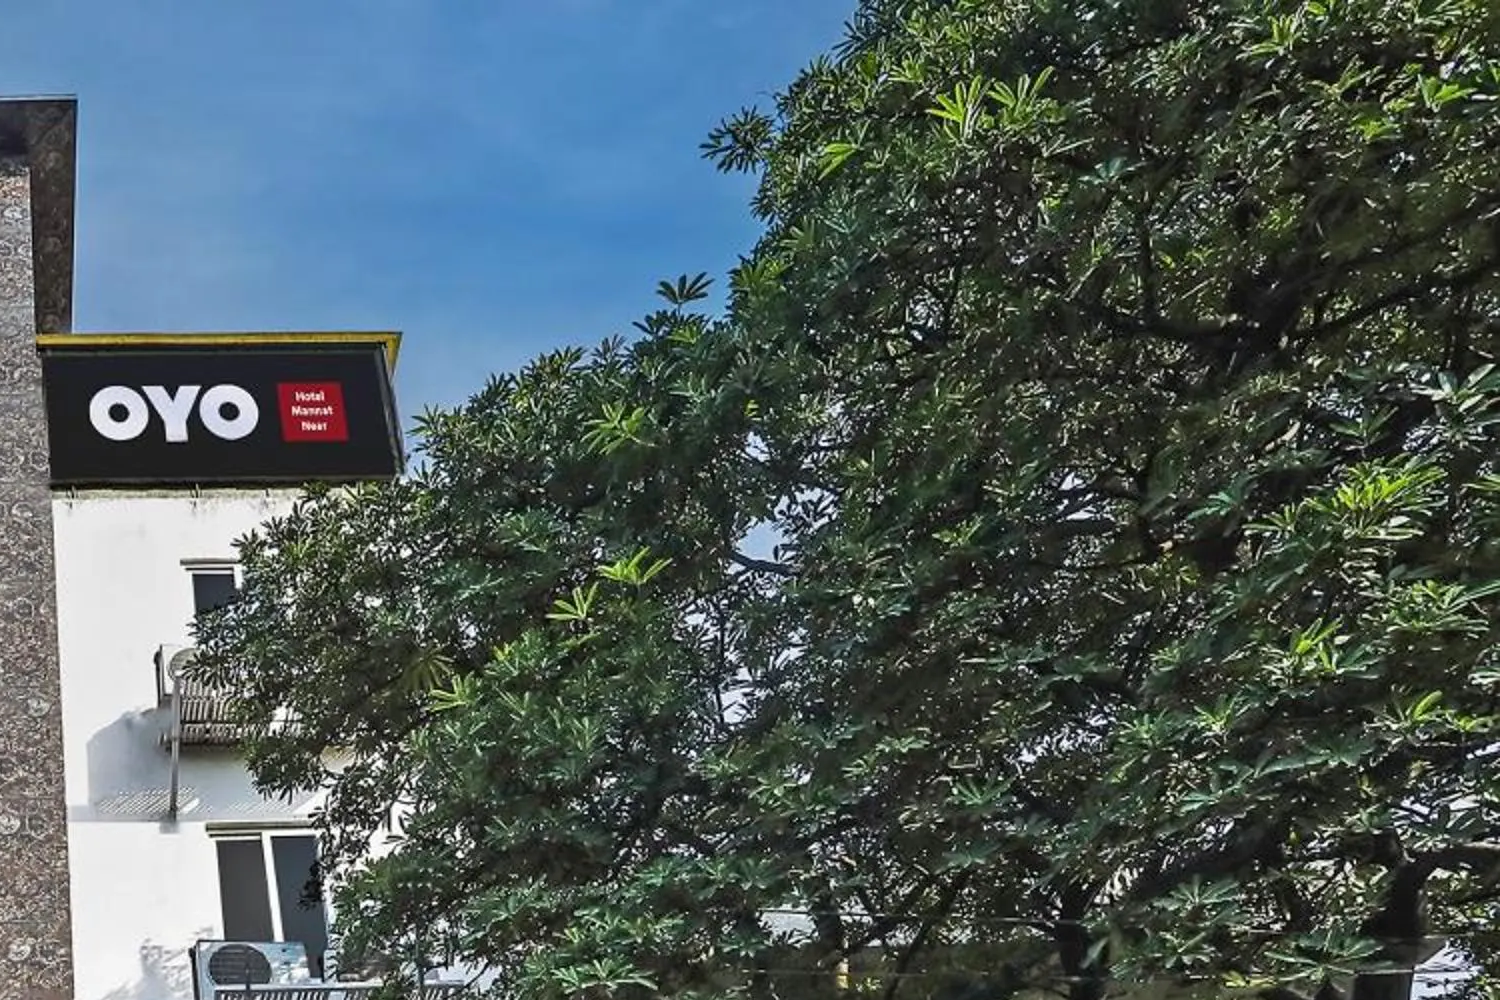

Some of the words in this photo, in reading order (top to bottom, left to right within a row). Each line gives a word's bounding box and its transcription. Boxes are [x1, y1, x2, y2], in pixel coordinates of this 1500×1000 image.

[295, 390, 325, 402] Hotel
[89, 384, 260, 443] OYO
[291, 405, 333, 417] Mannat
